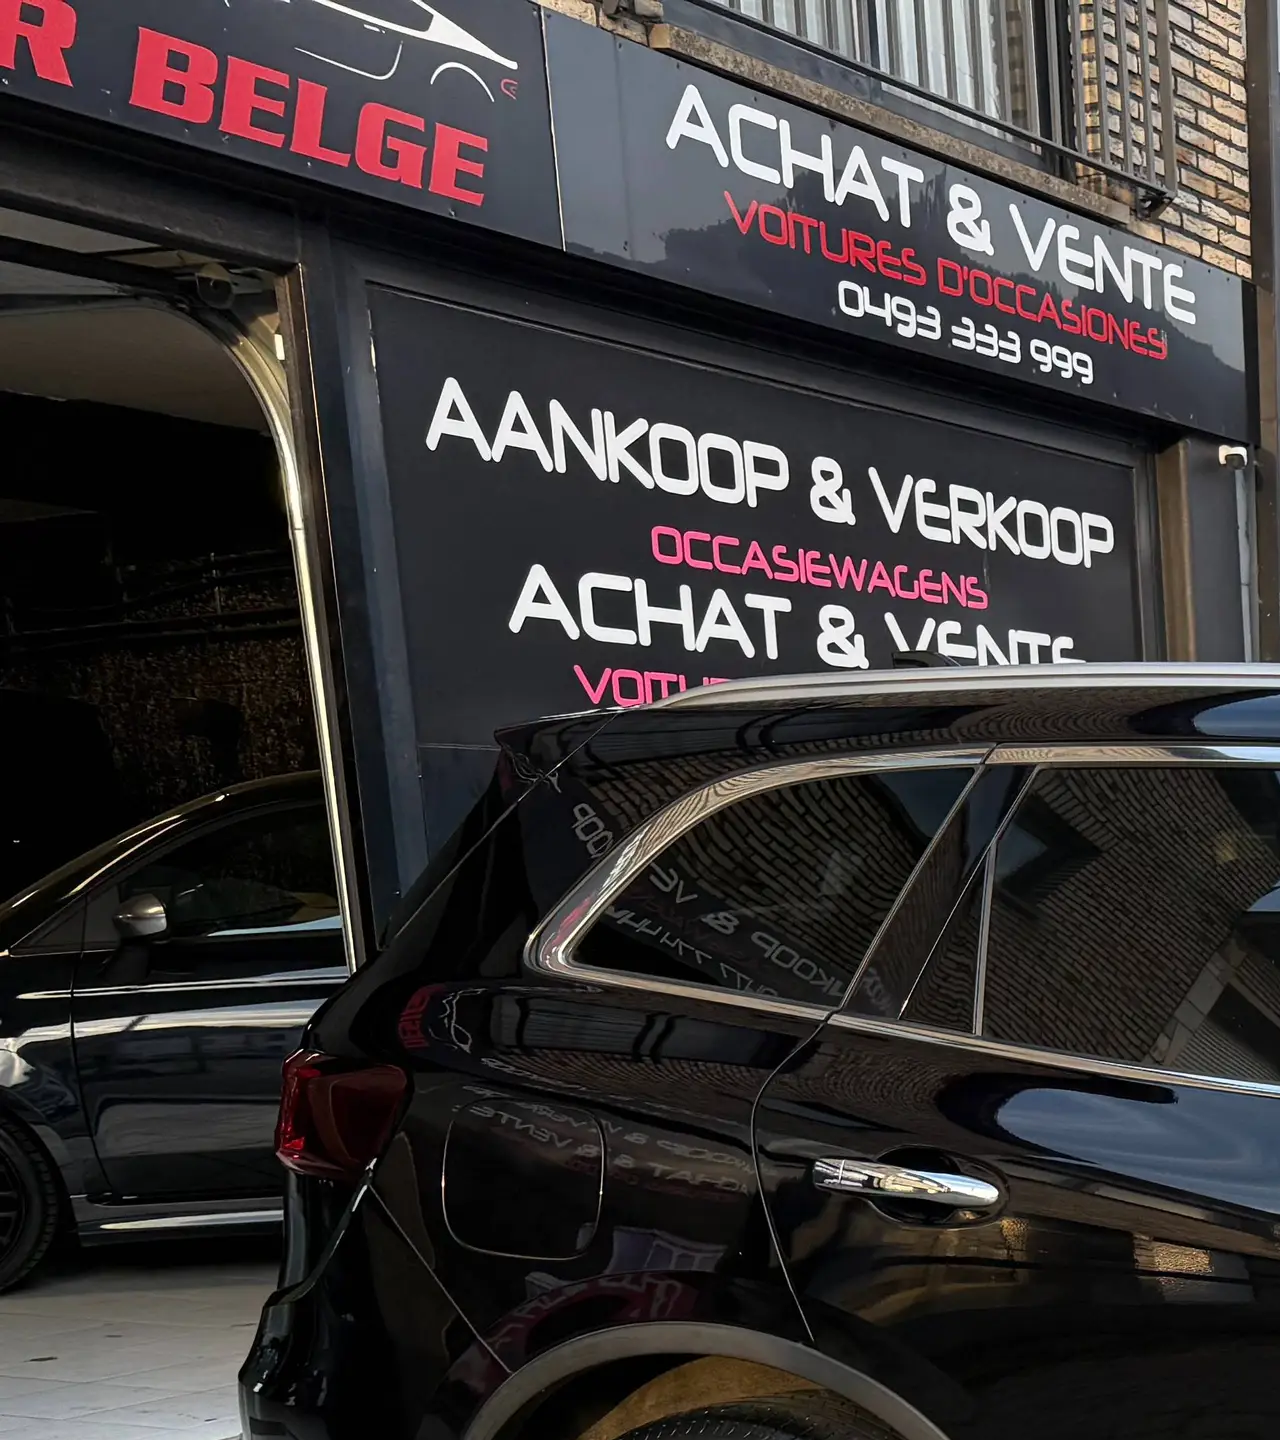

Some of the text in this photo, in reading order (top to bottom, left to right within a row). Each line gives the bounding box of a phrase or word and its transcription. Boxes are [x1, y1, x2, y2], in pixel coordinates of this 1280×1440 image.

[128, 26, 488, 207] BELGE
[665, 84, 1197, 325] ACHAT & VENTE
[724, 190, 1168, 360] VOITURES D'OCCASIONES
[838, 280, 1094, 385] 0493 333 999
[426, 376, 1115, 568] AANKOOP & VERKOOP
[508, 563, 792, 660] ACHAT
[817, 604, 869, 670] &
[651, 525, 989, 610] OCCASIEWAGENS
